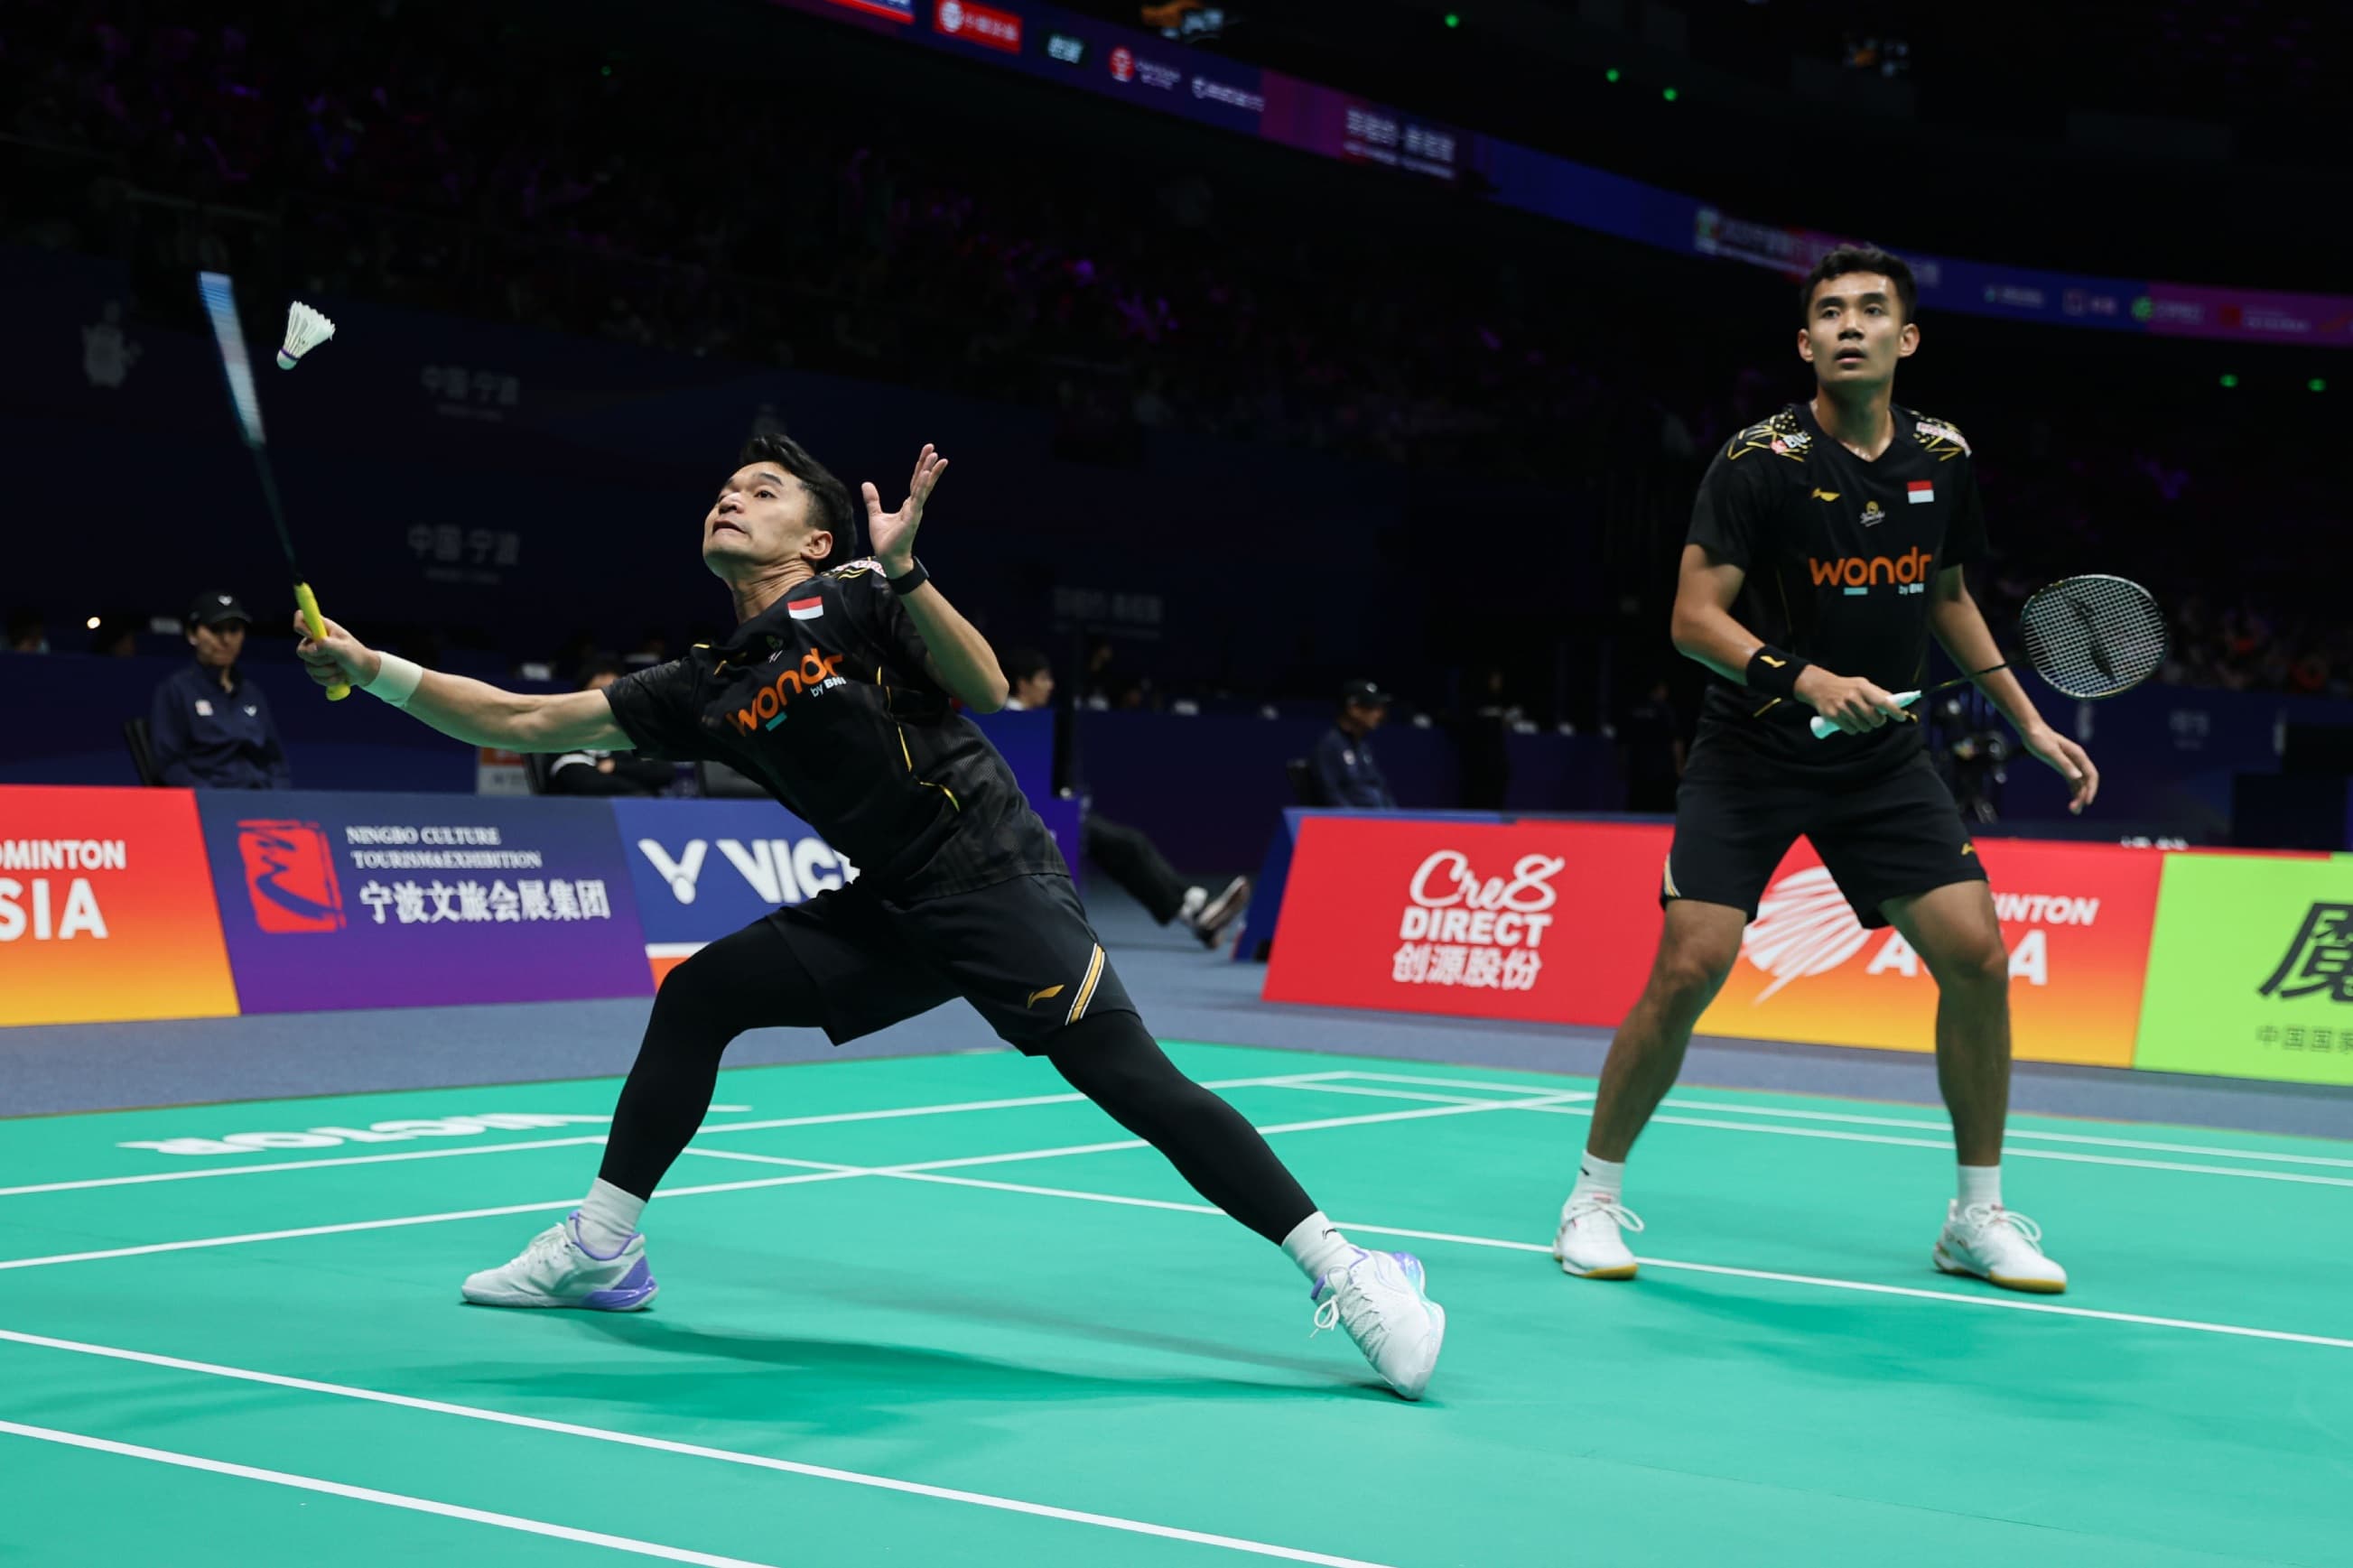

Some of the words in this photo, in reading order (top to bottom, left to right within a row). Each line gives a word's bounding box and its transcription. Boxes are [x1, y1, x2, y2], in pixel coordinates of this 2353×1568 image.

[1809, 545, 1933, 587] wondr
[725, 647, 843, 737] wondr
[809, 682, 824, 698] by
[823, 675, 847, 689] BNI
[420, 826, 501, 846] CULTURE
[358, 877, 611, 924] 宁波文旅会展集团
[1409, 849, 1566, 913] Cre8
[1400, 905, 1554, 948] DIRECT
[1992, 891, 2101, 926] INTON
[1391, 941, 1542, 991] 创源股份
